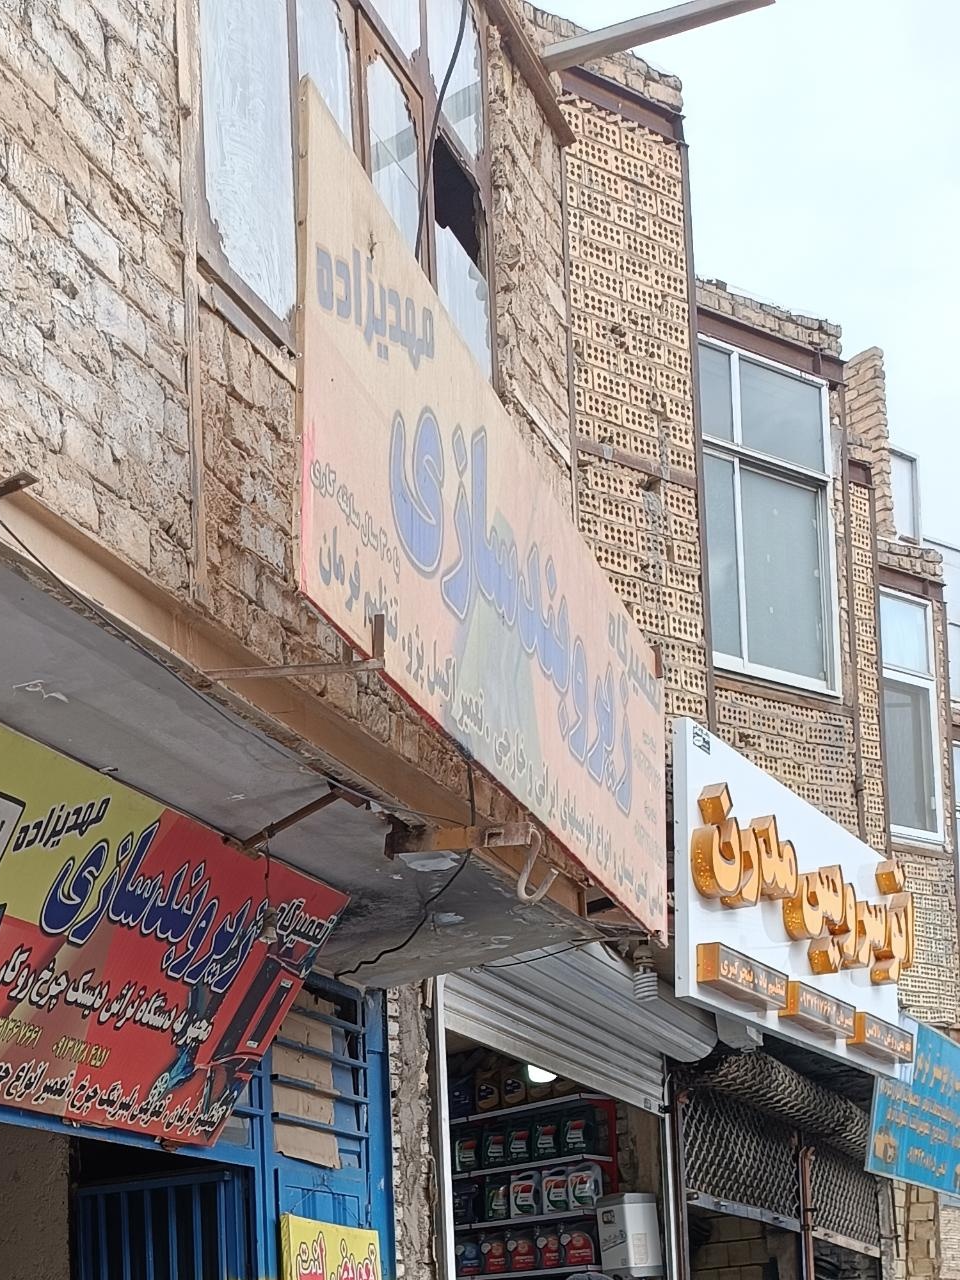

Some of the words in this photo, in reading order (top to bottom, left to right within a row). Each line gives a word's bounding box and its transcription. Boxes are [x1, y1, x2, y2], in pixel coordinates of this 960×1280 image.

[319, 526, 361, 612] فرمان
[451, 688, 486, 738] تعمیر
[493, 728, 527, 784] خارجی
[12, 797, 111, 852] مهدیزاده
[31, 960, 68, 1010] چرخ
[67, 970, 106, 1017] دیسک
[100, 982, 144, 1030] تراش
[134, 990, 176, 1031] دستگاه
[180, 1009, 213, 1046] مجهز
[4, 1058, 48, 1101] انواع
[32, 1073, 75, 1105] تعمیر
[69, 1074, 99, 1116] چرخ
[164, 1095, 201, 1135] فرمان
